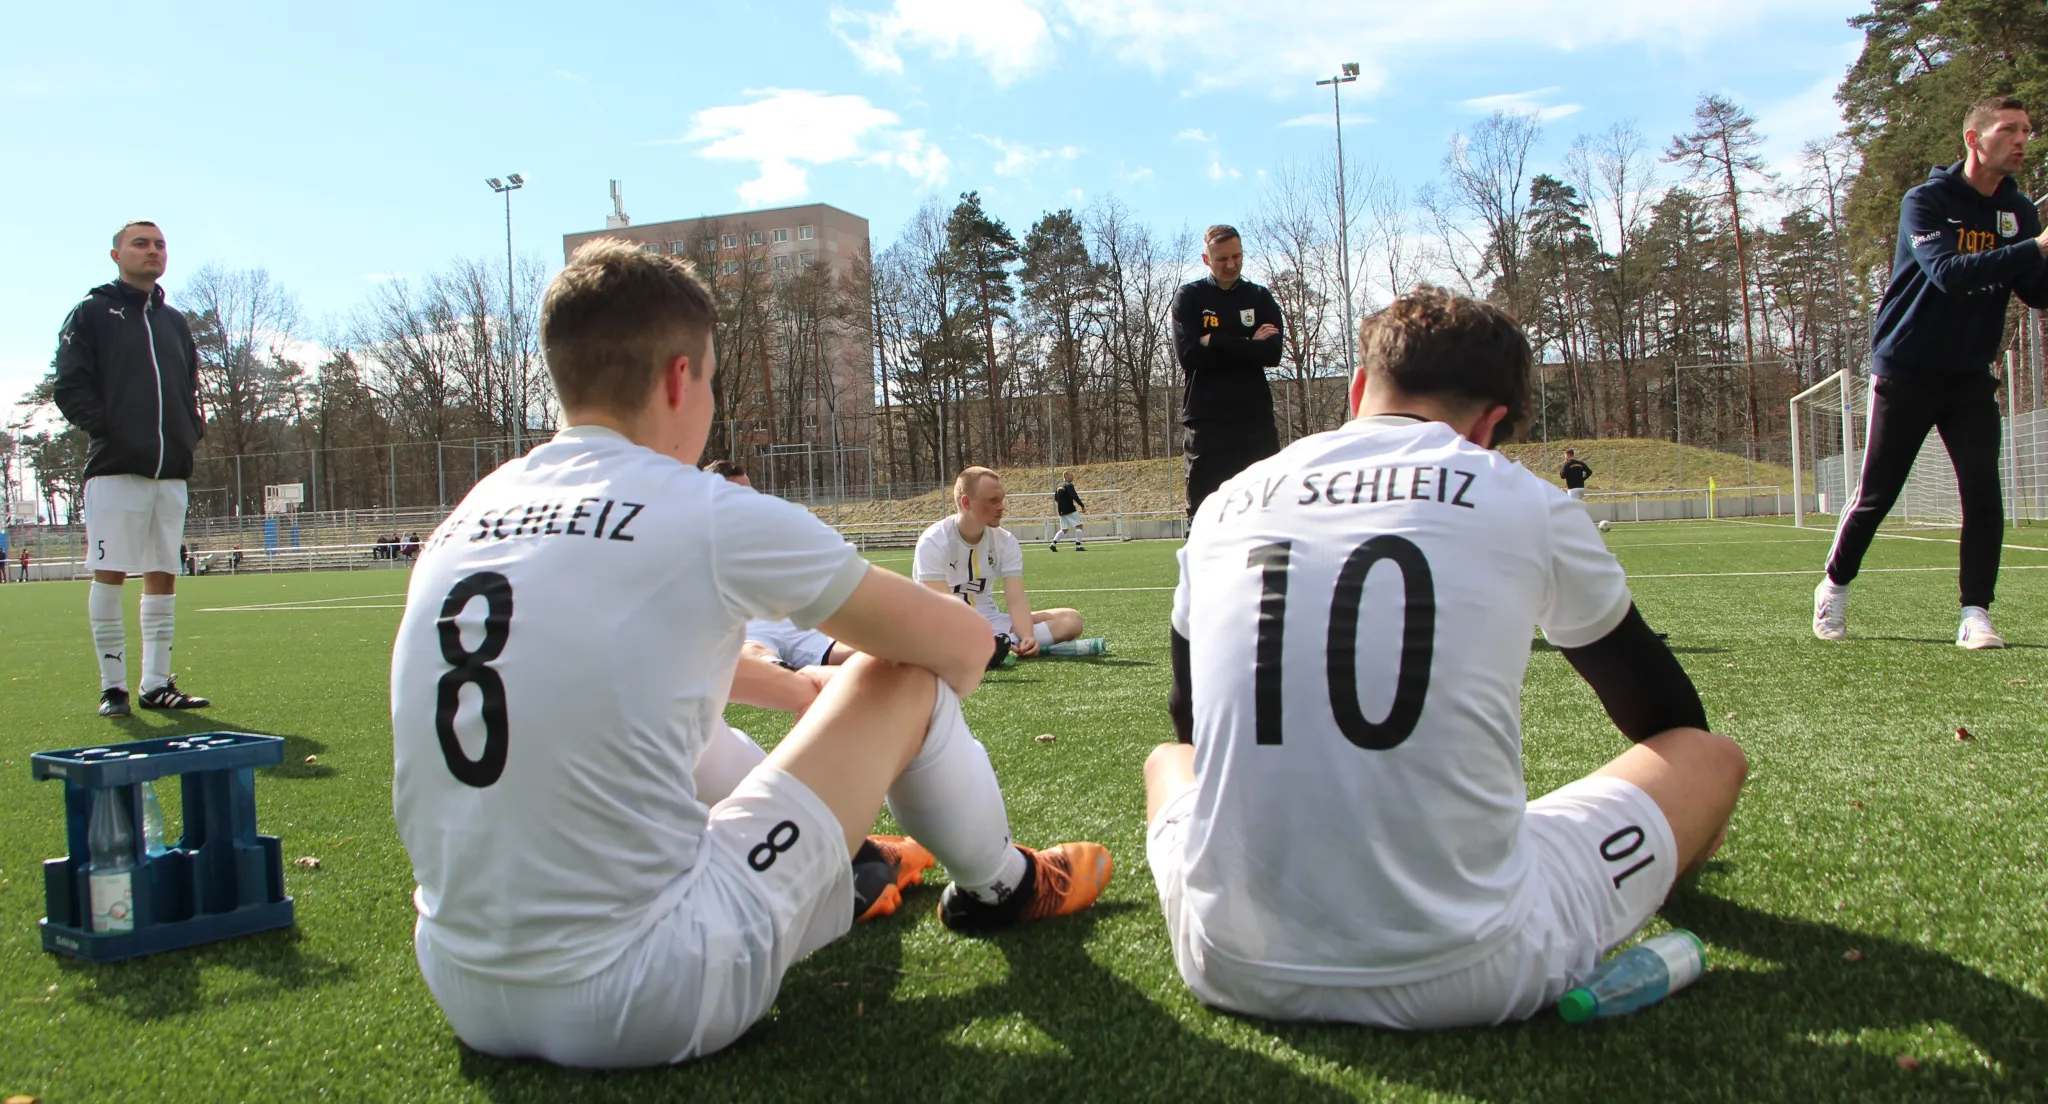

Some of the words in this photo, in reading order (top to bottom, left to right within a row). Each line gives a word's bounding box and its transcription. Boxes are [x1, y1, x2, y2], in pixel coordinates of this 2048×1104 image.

[1203, 315, 1219, 328] 78
[1298, 466, 1476, 509] SCHLEIZ
[469, 498, 645, 543] SCHLEIZ
[98, 540, 105, 560] 5
[1247, 534, 1436, 751] 10
[435, 571, 513, 788] 8
[747, 820, 800, 872] 8
[1600, 825, 1655, 890] 10
